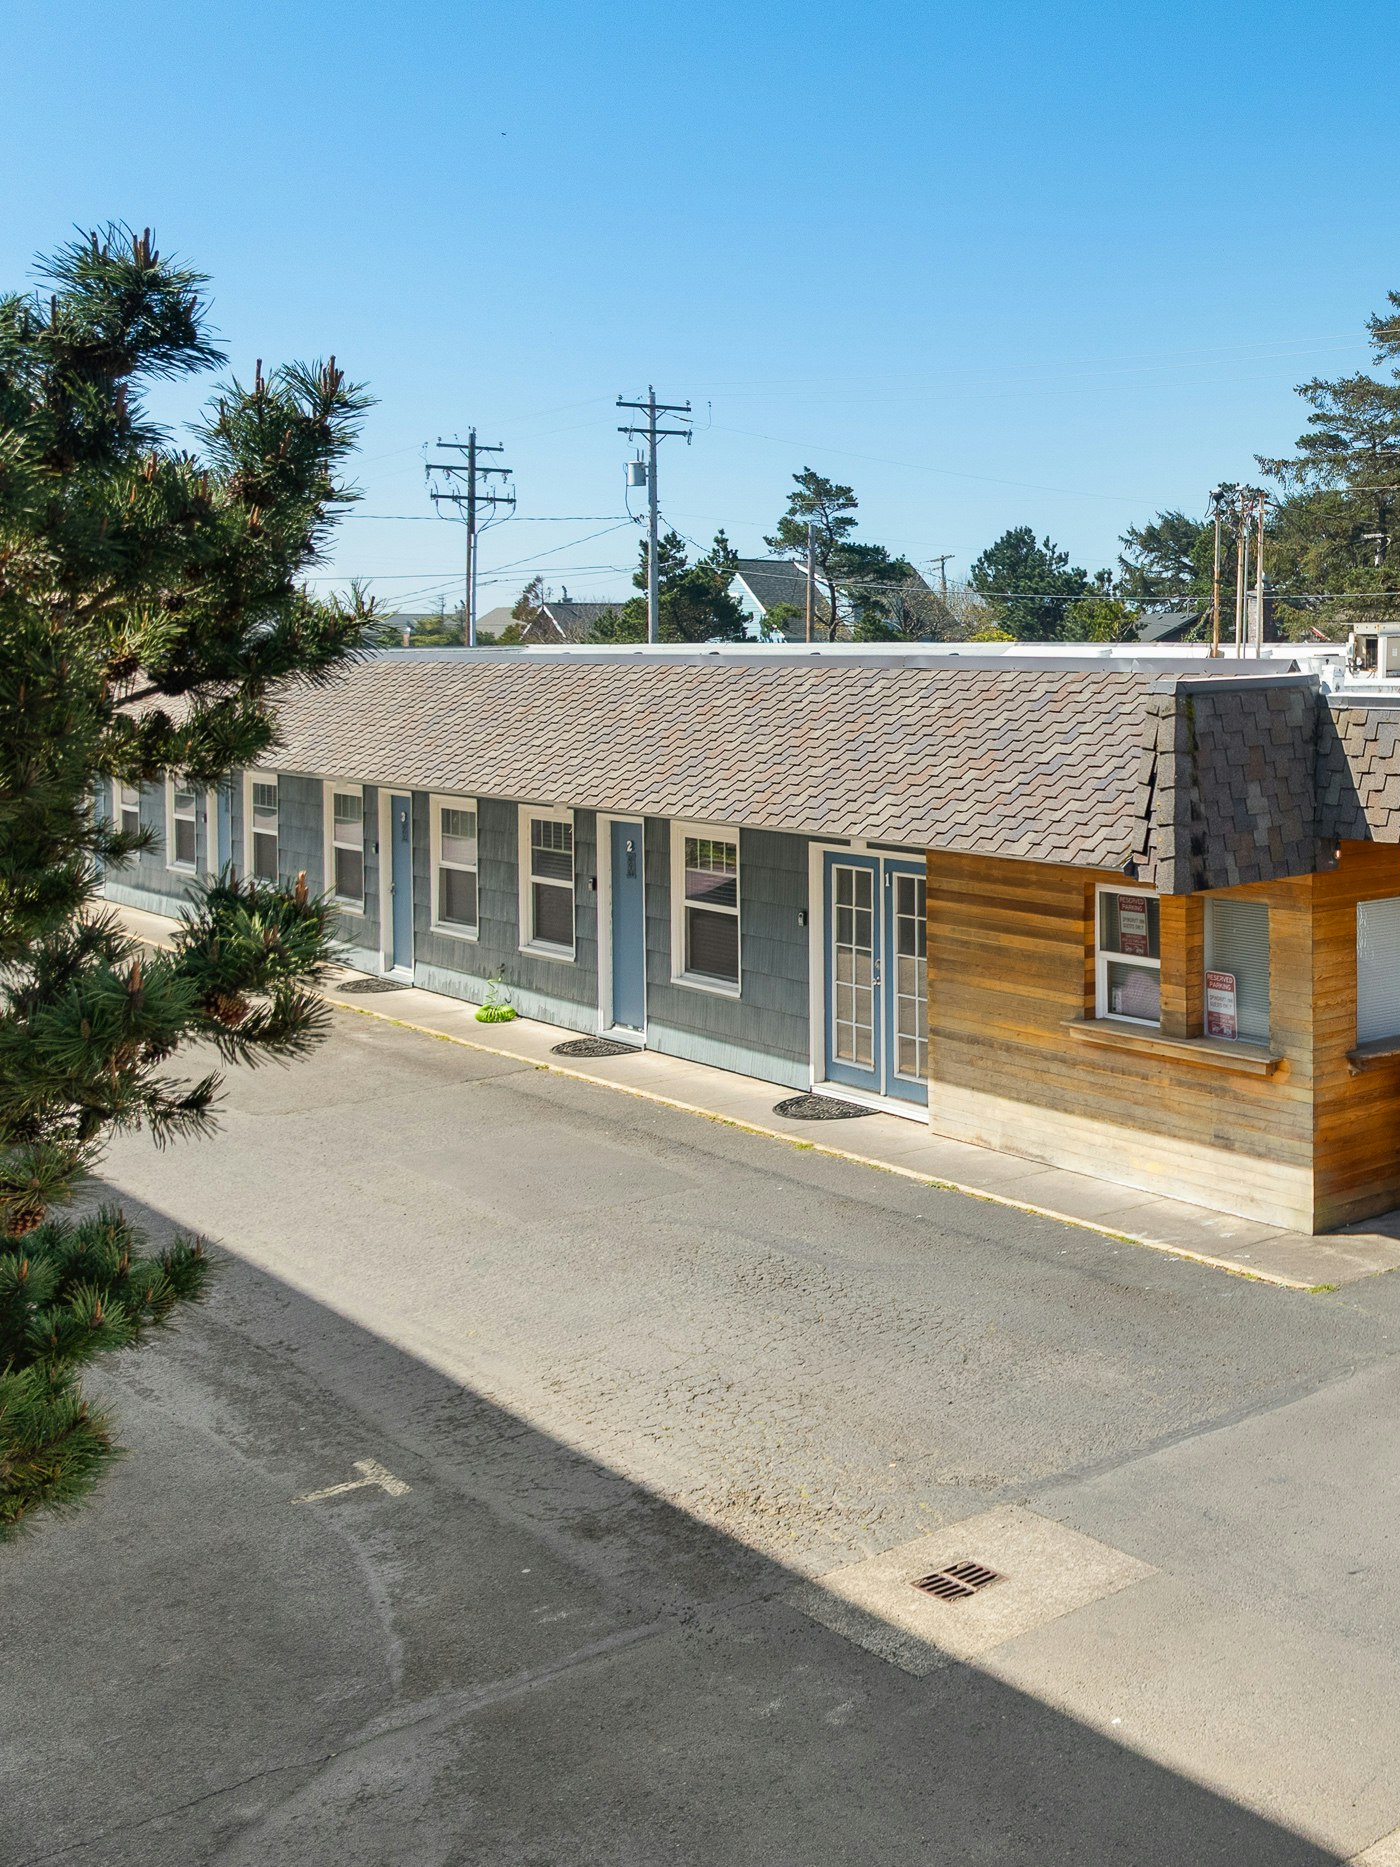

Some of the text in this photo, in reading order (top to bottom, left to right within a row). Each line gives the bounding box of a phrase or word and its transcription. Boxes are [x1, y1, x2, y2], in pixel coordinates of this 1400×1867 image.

[626, 840, 633, 852] 2
[885, 872, 890, 887] 1
[1121, 903, 1143, 912] PARKING
[1207, 973, 1233, 984] RESERVED
[1209, 981, 1232, 991] PARKING
